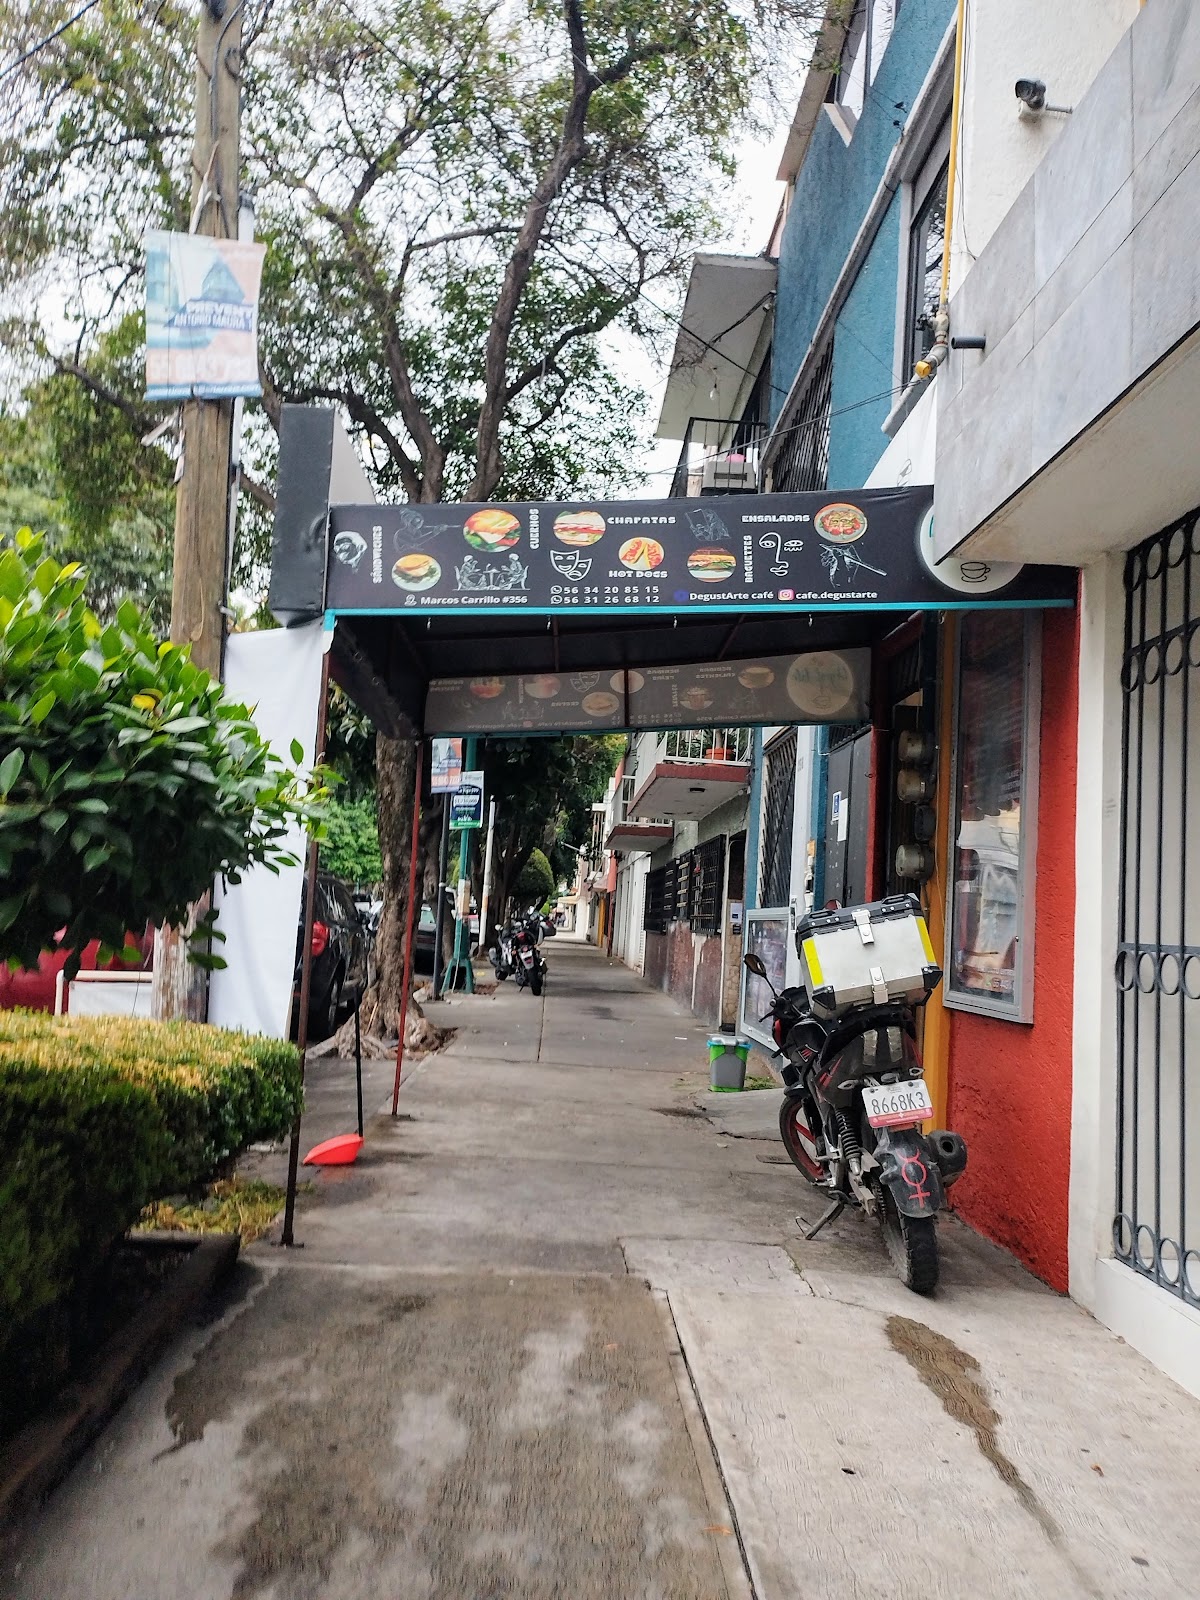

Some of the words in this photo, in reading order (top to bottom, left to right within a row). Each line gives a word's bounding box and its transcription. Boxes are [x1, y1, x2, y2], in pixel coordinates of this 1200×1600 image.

[607, 516, 676, 524] CHAPATAS
[529, 508, 540, 550] CUERNOS
[743, 535, 753, 583] BAGUETTES
[608, 570, 633, 578] HOT
[636, 570, 668, 578] DOGS
[604, 586, 619, 594] 20
[421, 596, 460, 605] Marcos
[461, 595, 501, 604] Carrillo
[502, 595, 528, 604] #356
[564, 596, 579, 604] 56
[584, 596, 599, 604] 31
[604, 596, 620, 604] 26
[624, 595, 639, 604] 68
[645, 595, 660, 603] 12
[689, 592, 750, 602] DegustArte
[751, 591, 774, 599] café
[795, 591, 878, 601] cafe.degustarte
[871, 1091, 926, 1115] 8668K3
